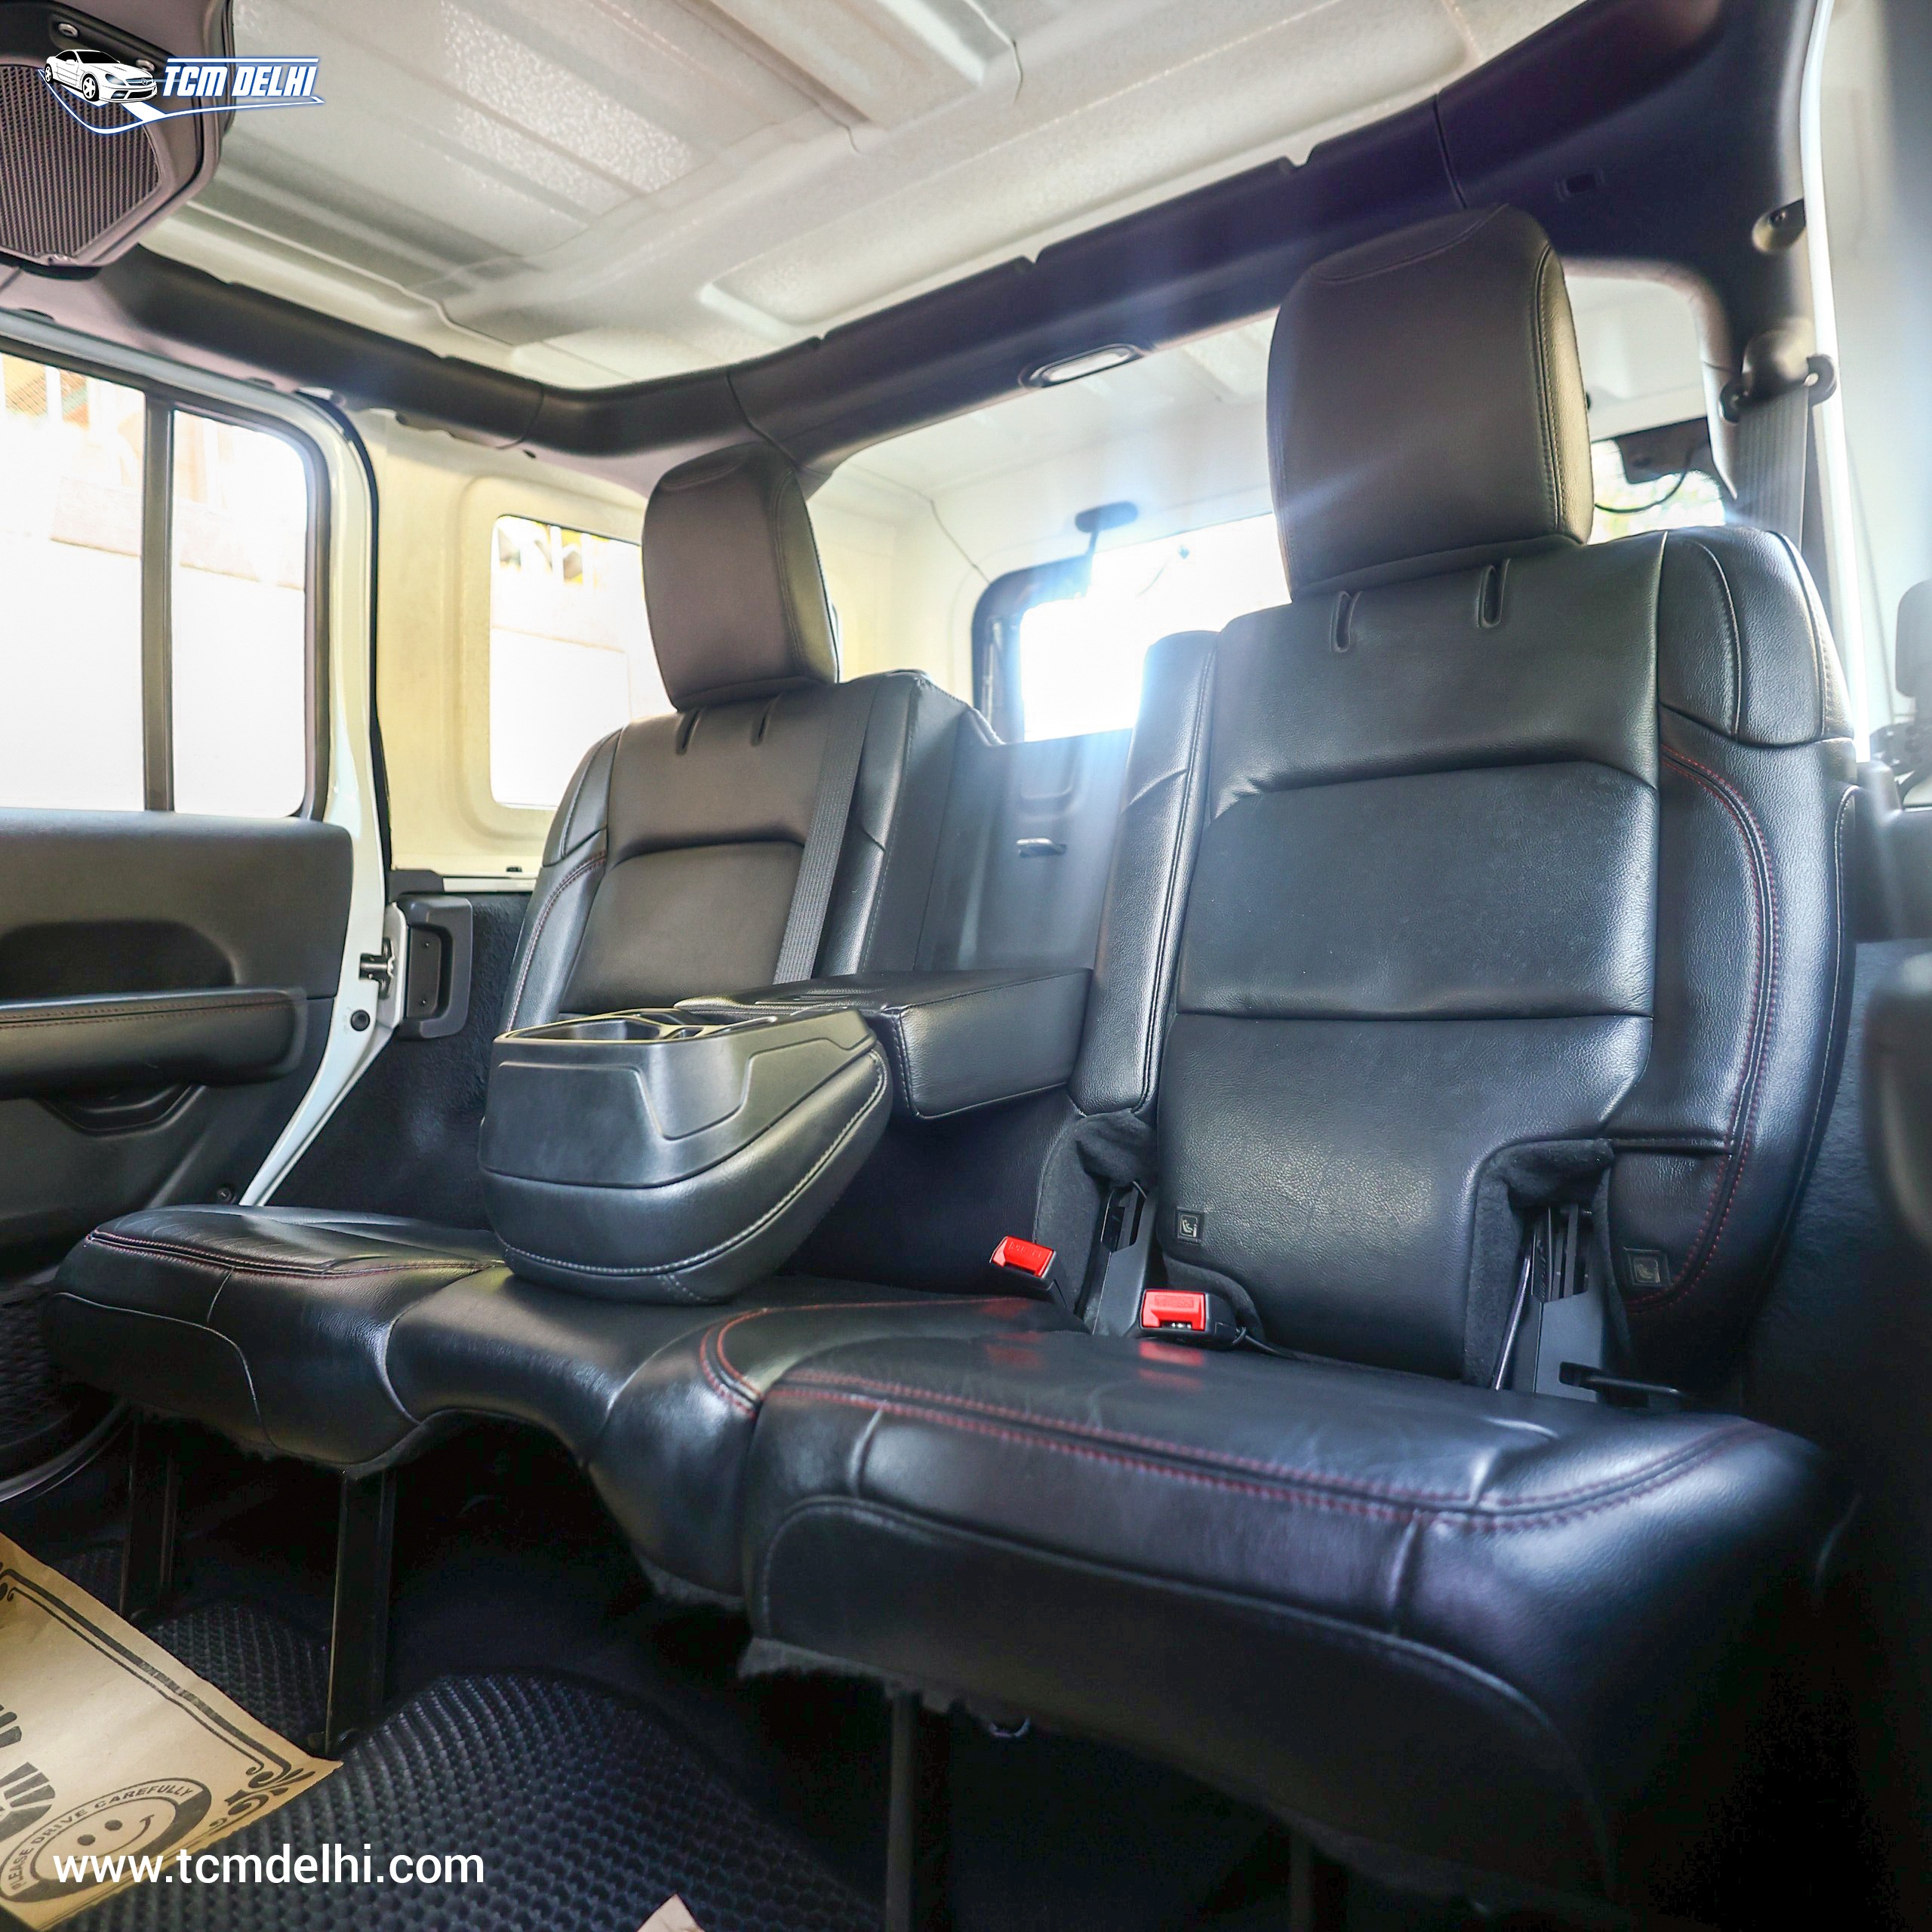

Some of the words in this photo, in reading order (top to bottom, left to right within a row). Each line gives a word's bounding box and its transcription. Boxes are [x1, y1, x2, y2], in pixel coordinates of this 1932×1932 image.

[8, 1847, 35, 1890] PLEASE
[31, 1809, 88, 1844] DRIVE
[94, 1784, 194, 1809] CAREFULLY
